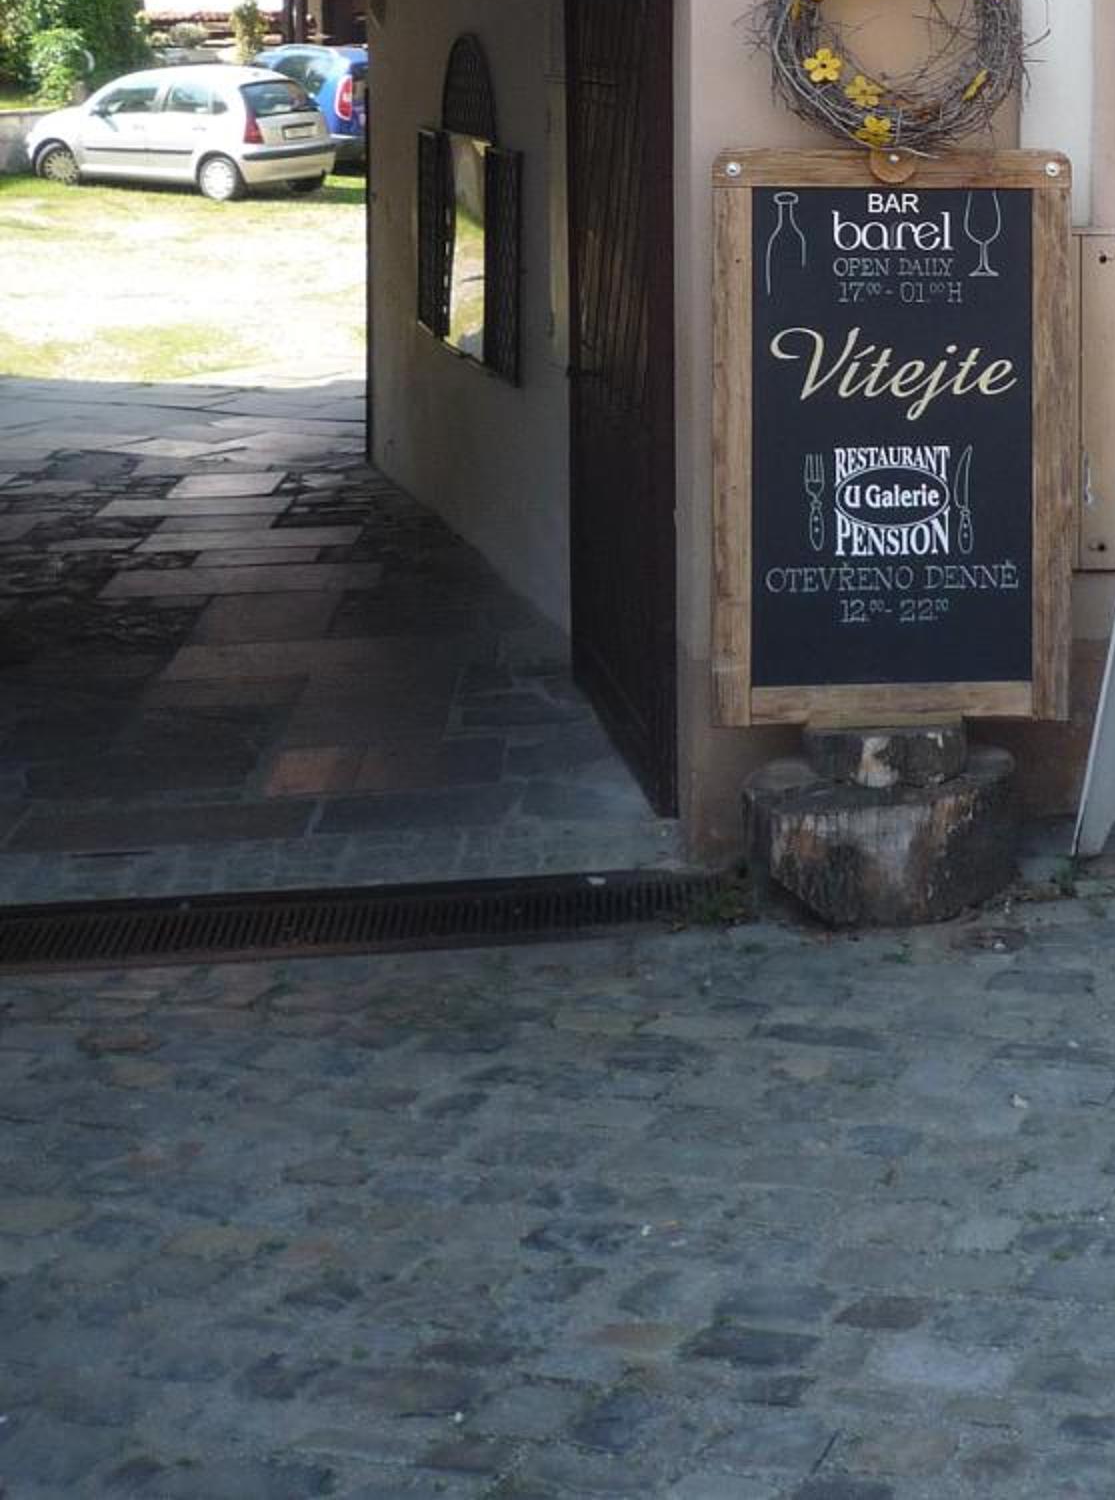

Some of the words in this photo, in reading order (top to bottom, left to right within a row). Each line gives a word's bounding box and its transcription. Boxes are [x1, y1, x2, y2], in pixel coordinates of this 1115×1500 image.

[867, 193, 920, 213] BAR
[832, 209, 955, 251] barel
[833, 257, 890, 277] OPEN
[897, 257, 954, 277] DAILY
[769, 326, 1018, 422] Vítejte
[834, 445, 949, 486] RESTAURANT
[865, 483, 940, 509] Galerie
[834, 506, 949, 557] PENSION
[765, 561, 914, 593] OTEVŘENO
[925, 559, 1019, 589] DENNĚ
